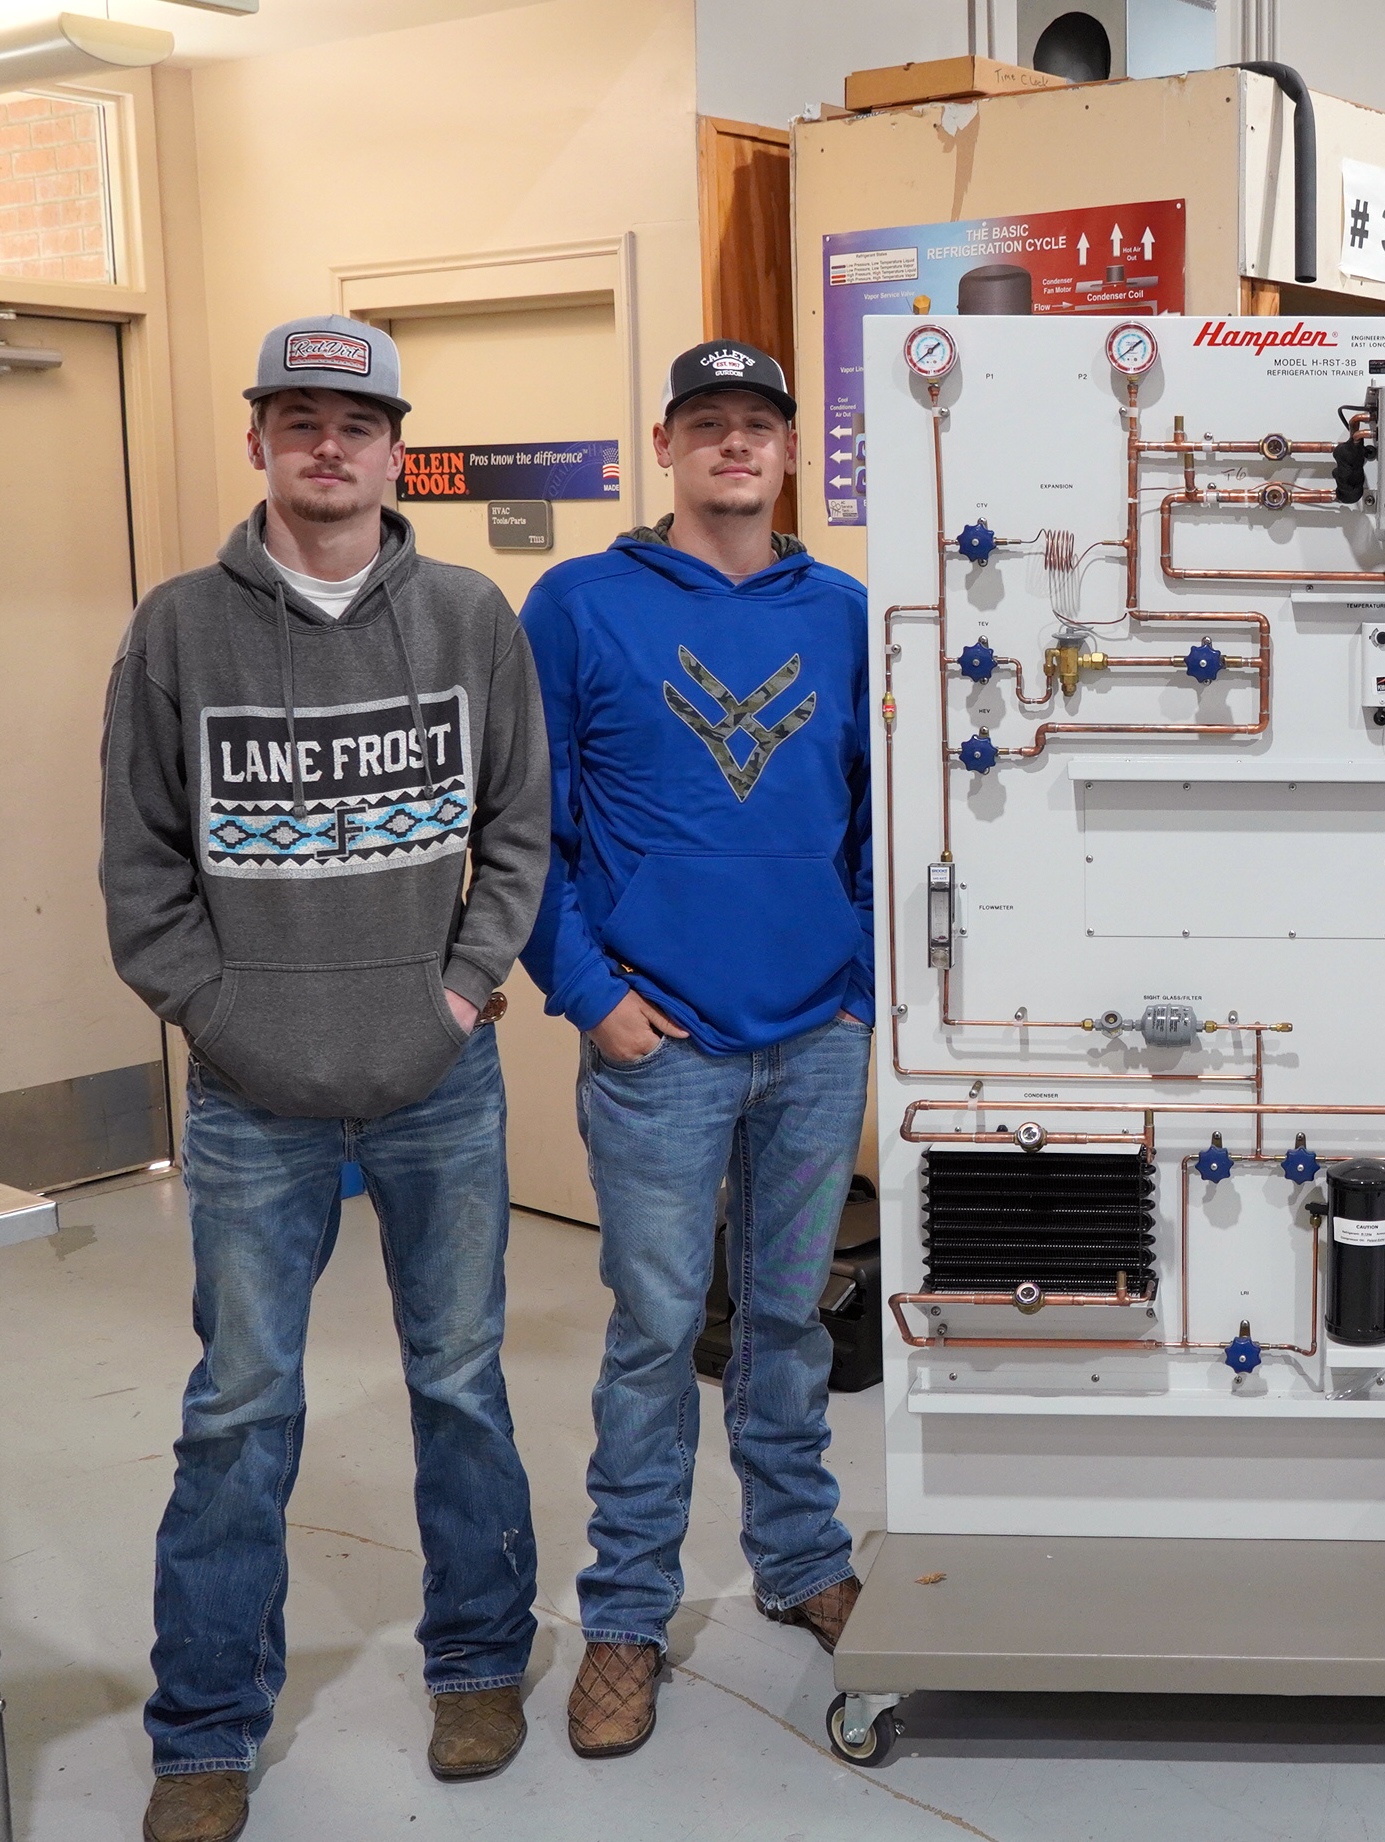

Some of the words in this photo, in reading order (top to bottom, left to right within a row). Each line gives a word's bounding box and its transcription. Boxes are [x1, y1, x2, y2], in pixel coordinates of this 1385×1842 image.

[995, 69, 1016, 83] Time
[1021, 75, 1048, 87] Clock
[966, 228, 989, 242] THE
[992, 224, 1029, 239] BASIC
[1350, 200, 1369, 248] #
[927, 240, 1022, 260] REFRIGERATION
[1025, 236, 1067, 251] CYCLE
[1042, 277, 1073, 285] Condenser
[1087, 292, 1126, 302] Condenser
[1128, 290, 1143, 299] Coil
[1034, 303, 1050, 311] Flow
[1193, 322, 1337, 356] Hampden
[294, 340, 321, 357] Red
[325, 342, 359, 358] Dirt
[700, 349, 755, 366] CALLEY'S
[405, 453, 464, 474] KLEIN
[470, 454, 488, 466] Pros
[491, 453, 514, 465] know
[516, 451, 531, 465] the
[405, 474, 466, 495] TOOLS
[492, 517, 526, 525] Tools/Parts
[221, 740, 322, 782] LANE
[332, 722, 451, 780] FROST
